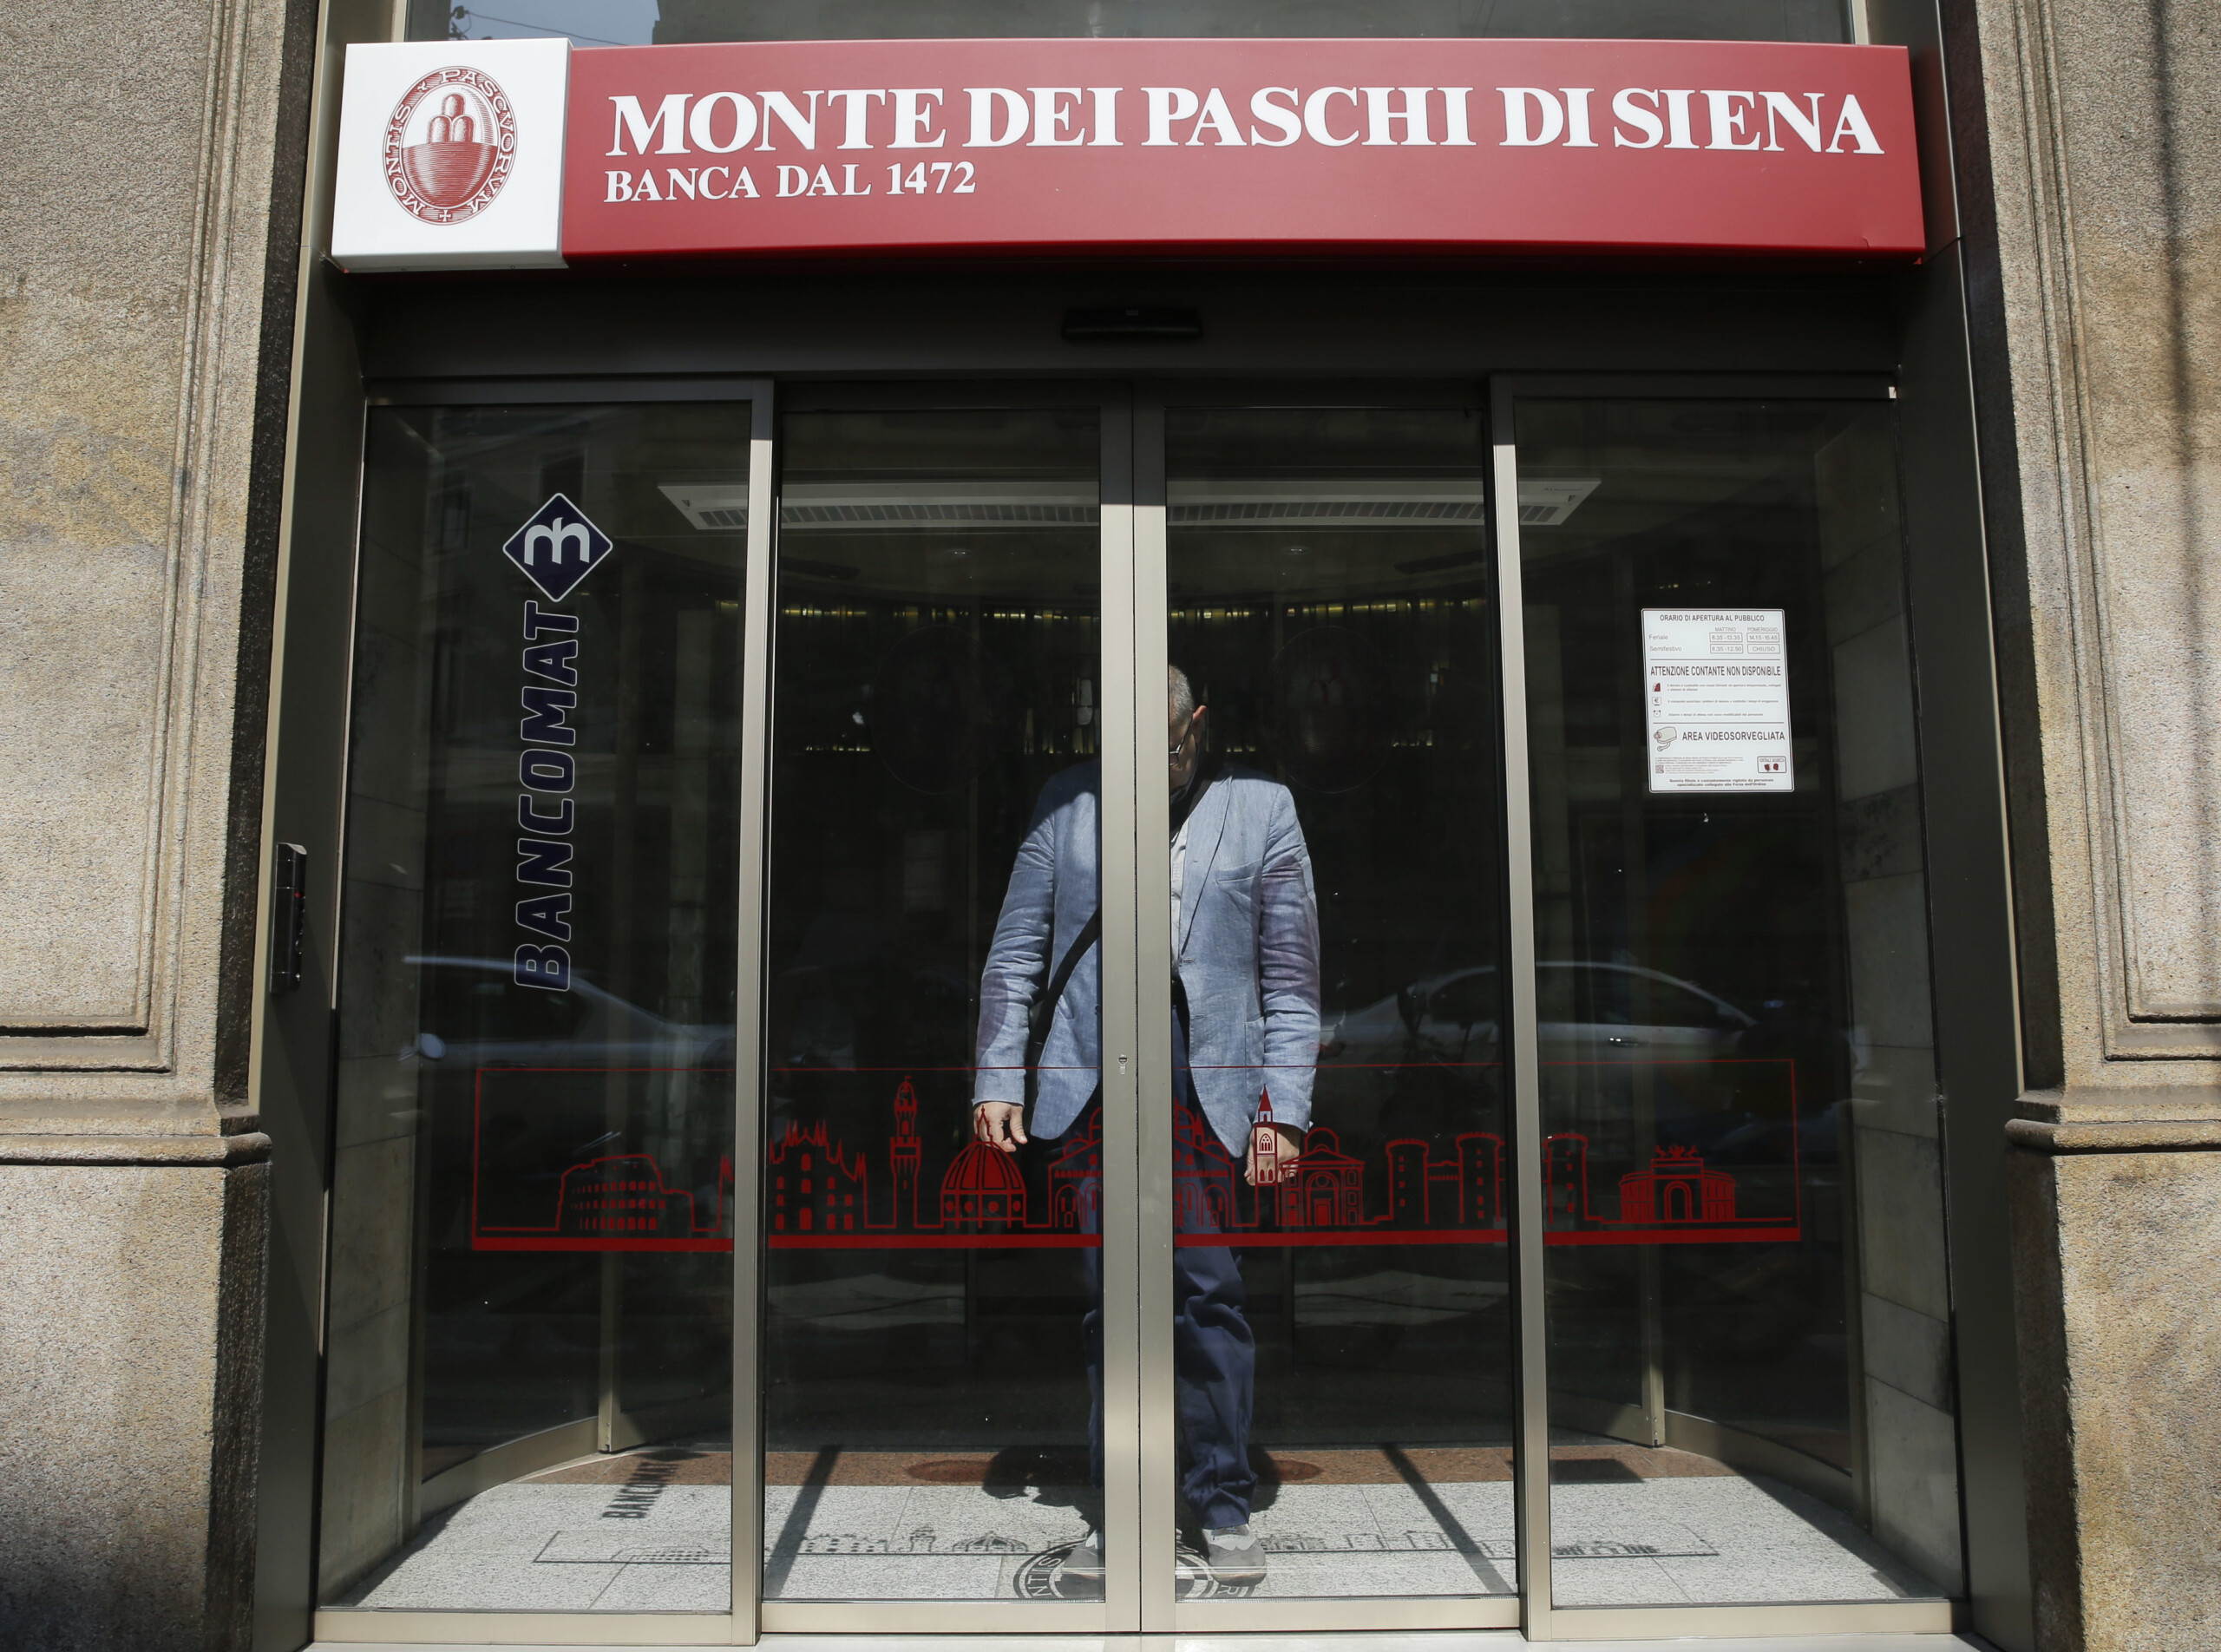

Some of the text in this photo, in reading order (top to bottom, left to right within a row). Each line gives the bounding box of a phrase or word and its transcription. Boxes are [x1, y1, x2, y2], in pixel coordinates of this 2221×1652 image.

[439, 69, 514, 214] PASCVORVM
[605, 86, 1885, 157] MONTE DEI PASCHI DI SIENA
[385, 104, 425, 215] MONTIS
[603, 161, 977, 203] BANCA DAL 1472
[1650, 665, 1781, 676] ATTENZIONE CONTANTE NON DISPONIBILE
[1681, 731, 1785, 741] AREA VIDEOSORVEGLIATA
[514, 600, 580, 992] BANCOMAT
